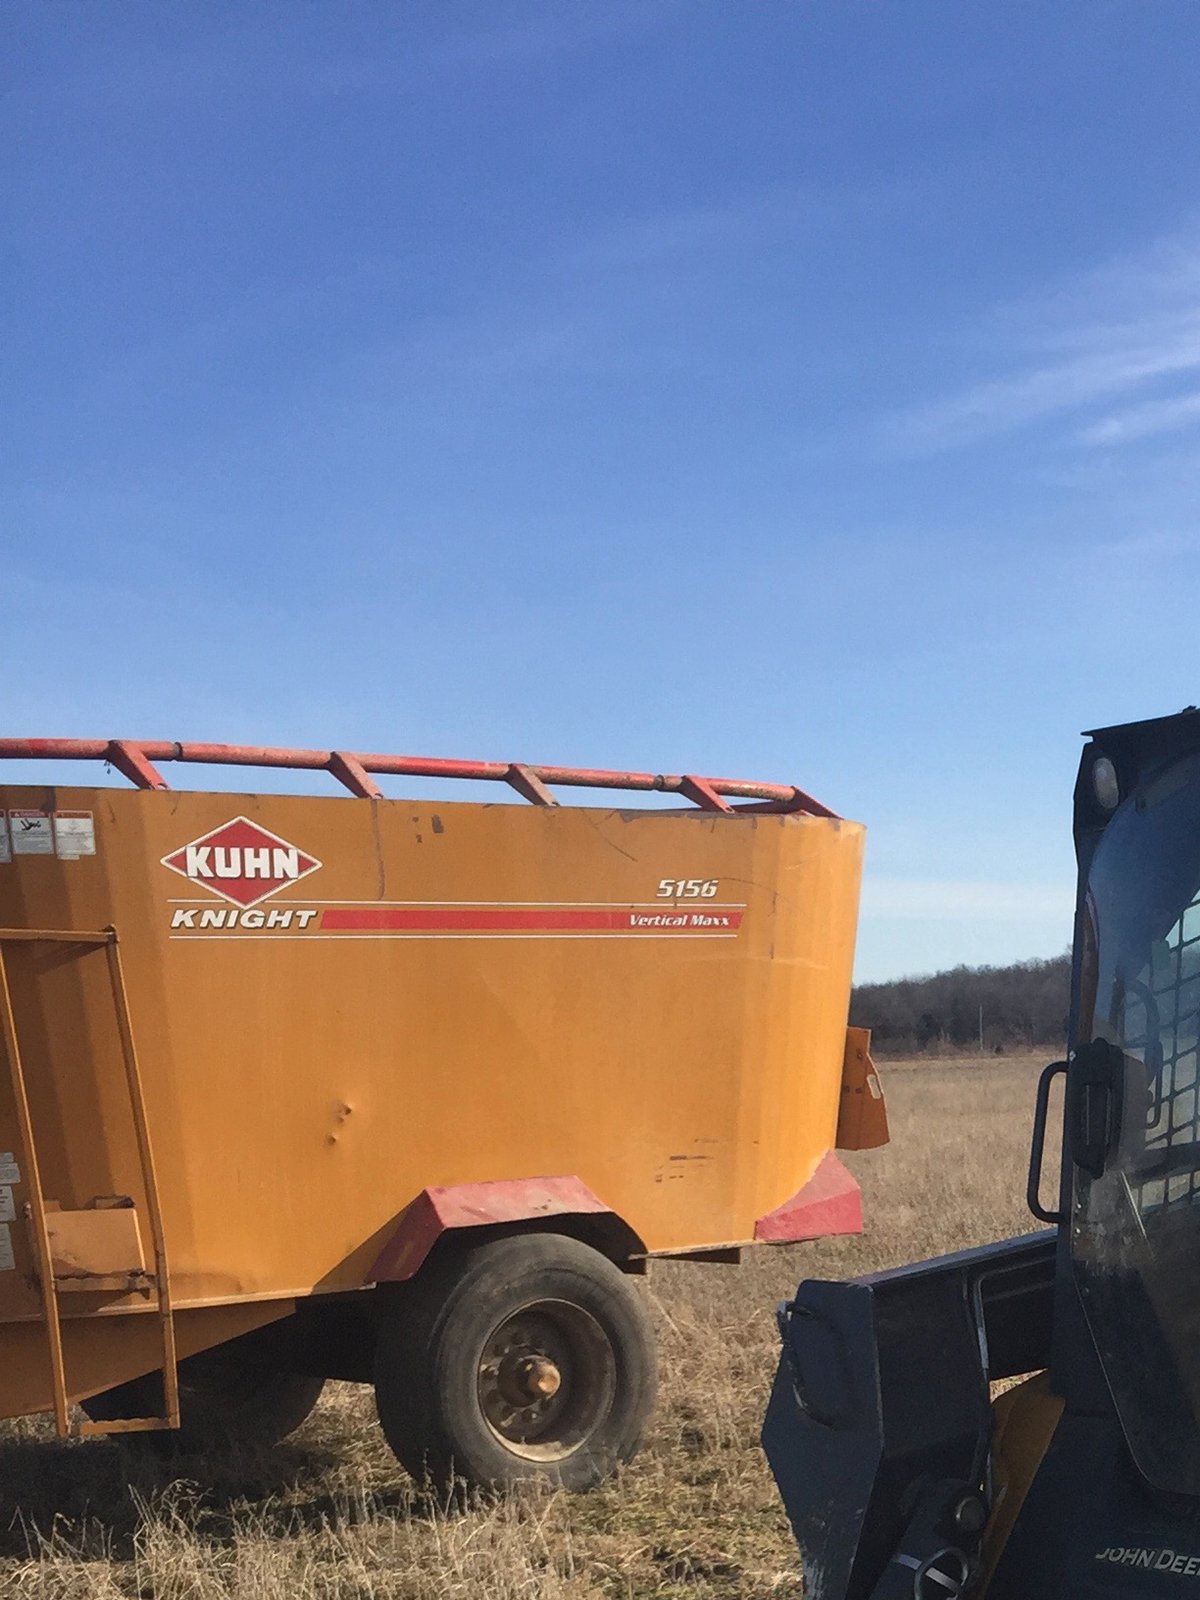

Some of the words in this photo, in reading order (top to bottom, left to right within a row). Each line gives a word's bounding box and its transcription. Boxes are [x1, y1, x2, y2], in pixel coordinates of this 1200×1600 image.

[185, 846, 300, 879] KUHN
[656, 879, 719, 898] 5156
[170, 909, 317, 929] KNIGHT
[630, 914, 688, 926] Vertical
[690, 914, 730, 926] Maxx
[1095, 1547, 1155, 1568] JOHN
